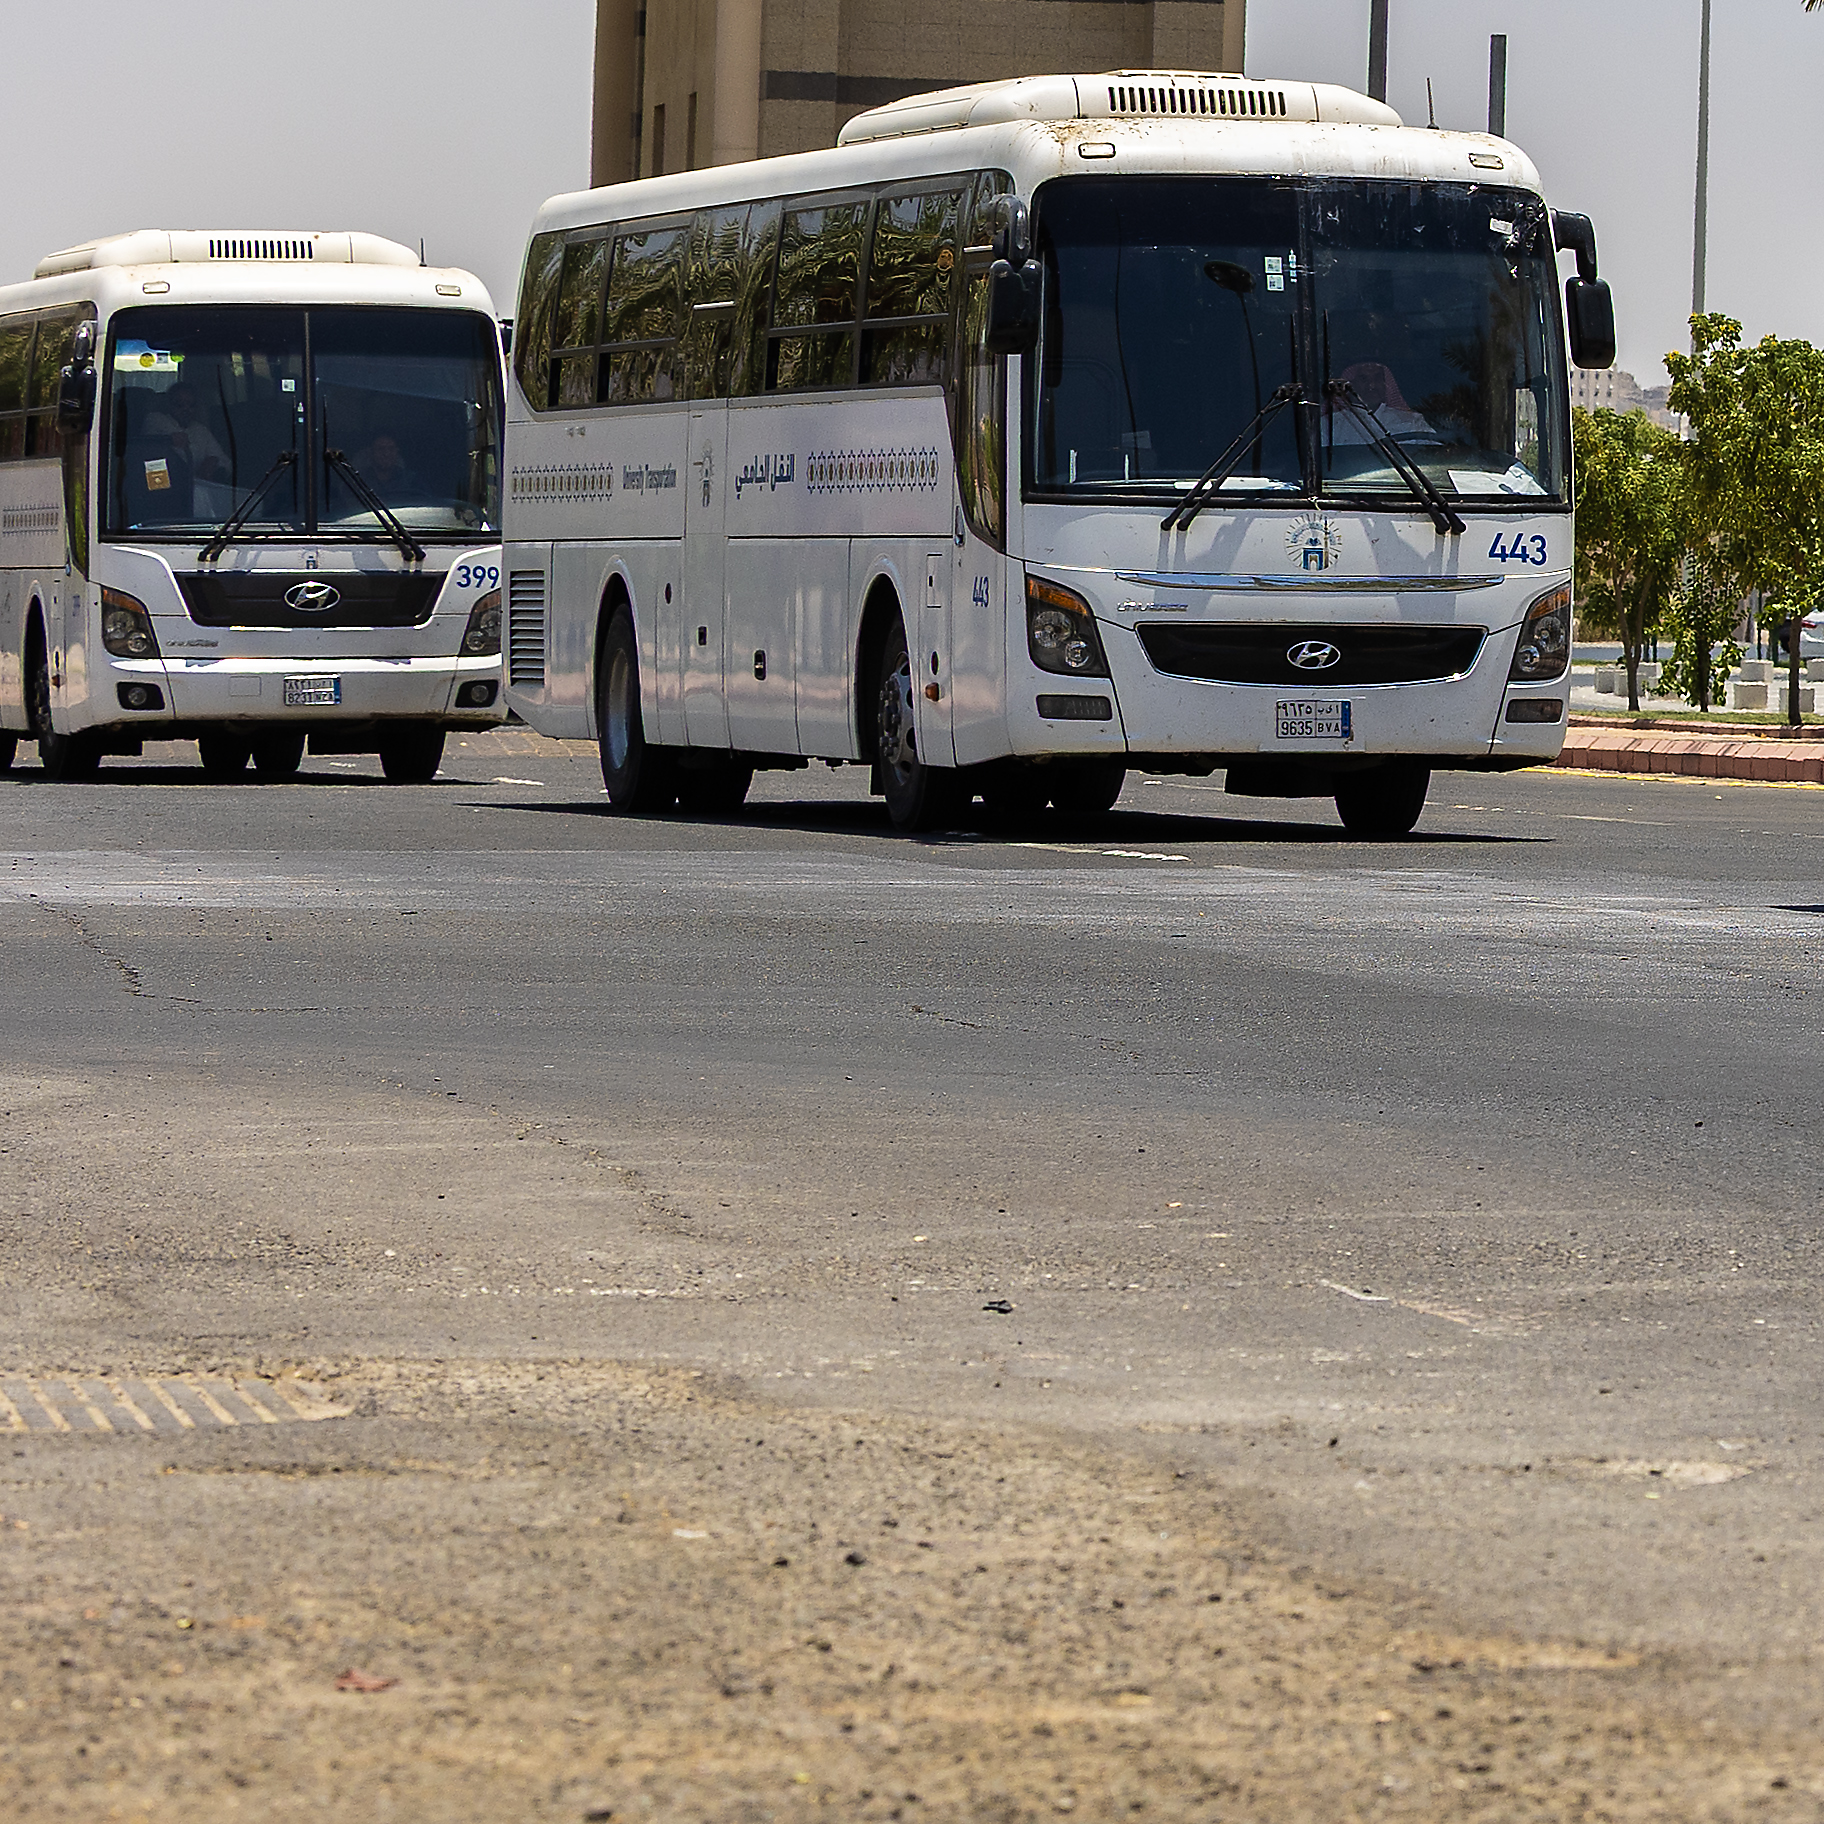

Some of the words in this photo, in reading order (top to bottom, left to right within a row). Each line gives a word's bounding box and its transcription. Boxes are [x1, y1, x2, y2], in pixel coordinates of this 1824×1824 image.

[735, 454, 770, 500] الجامعي
[770, 454, 795, 492] النقل
[1488, 532, 1548, 567] 443
[456, 564, 500, 589] 399
[972, 576, 990, 607] 443
[1281, 720, 1313, 736] 9635
[1317, 722, 1340, 733] BVA
